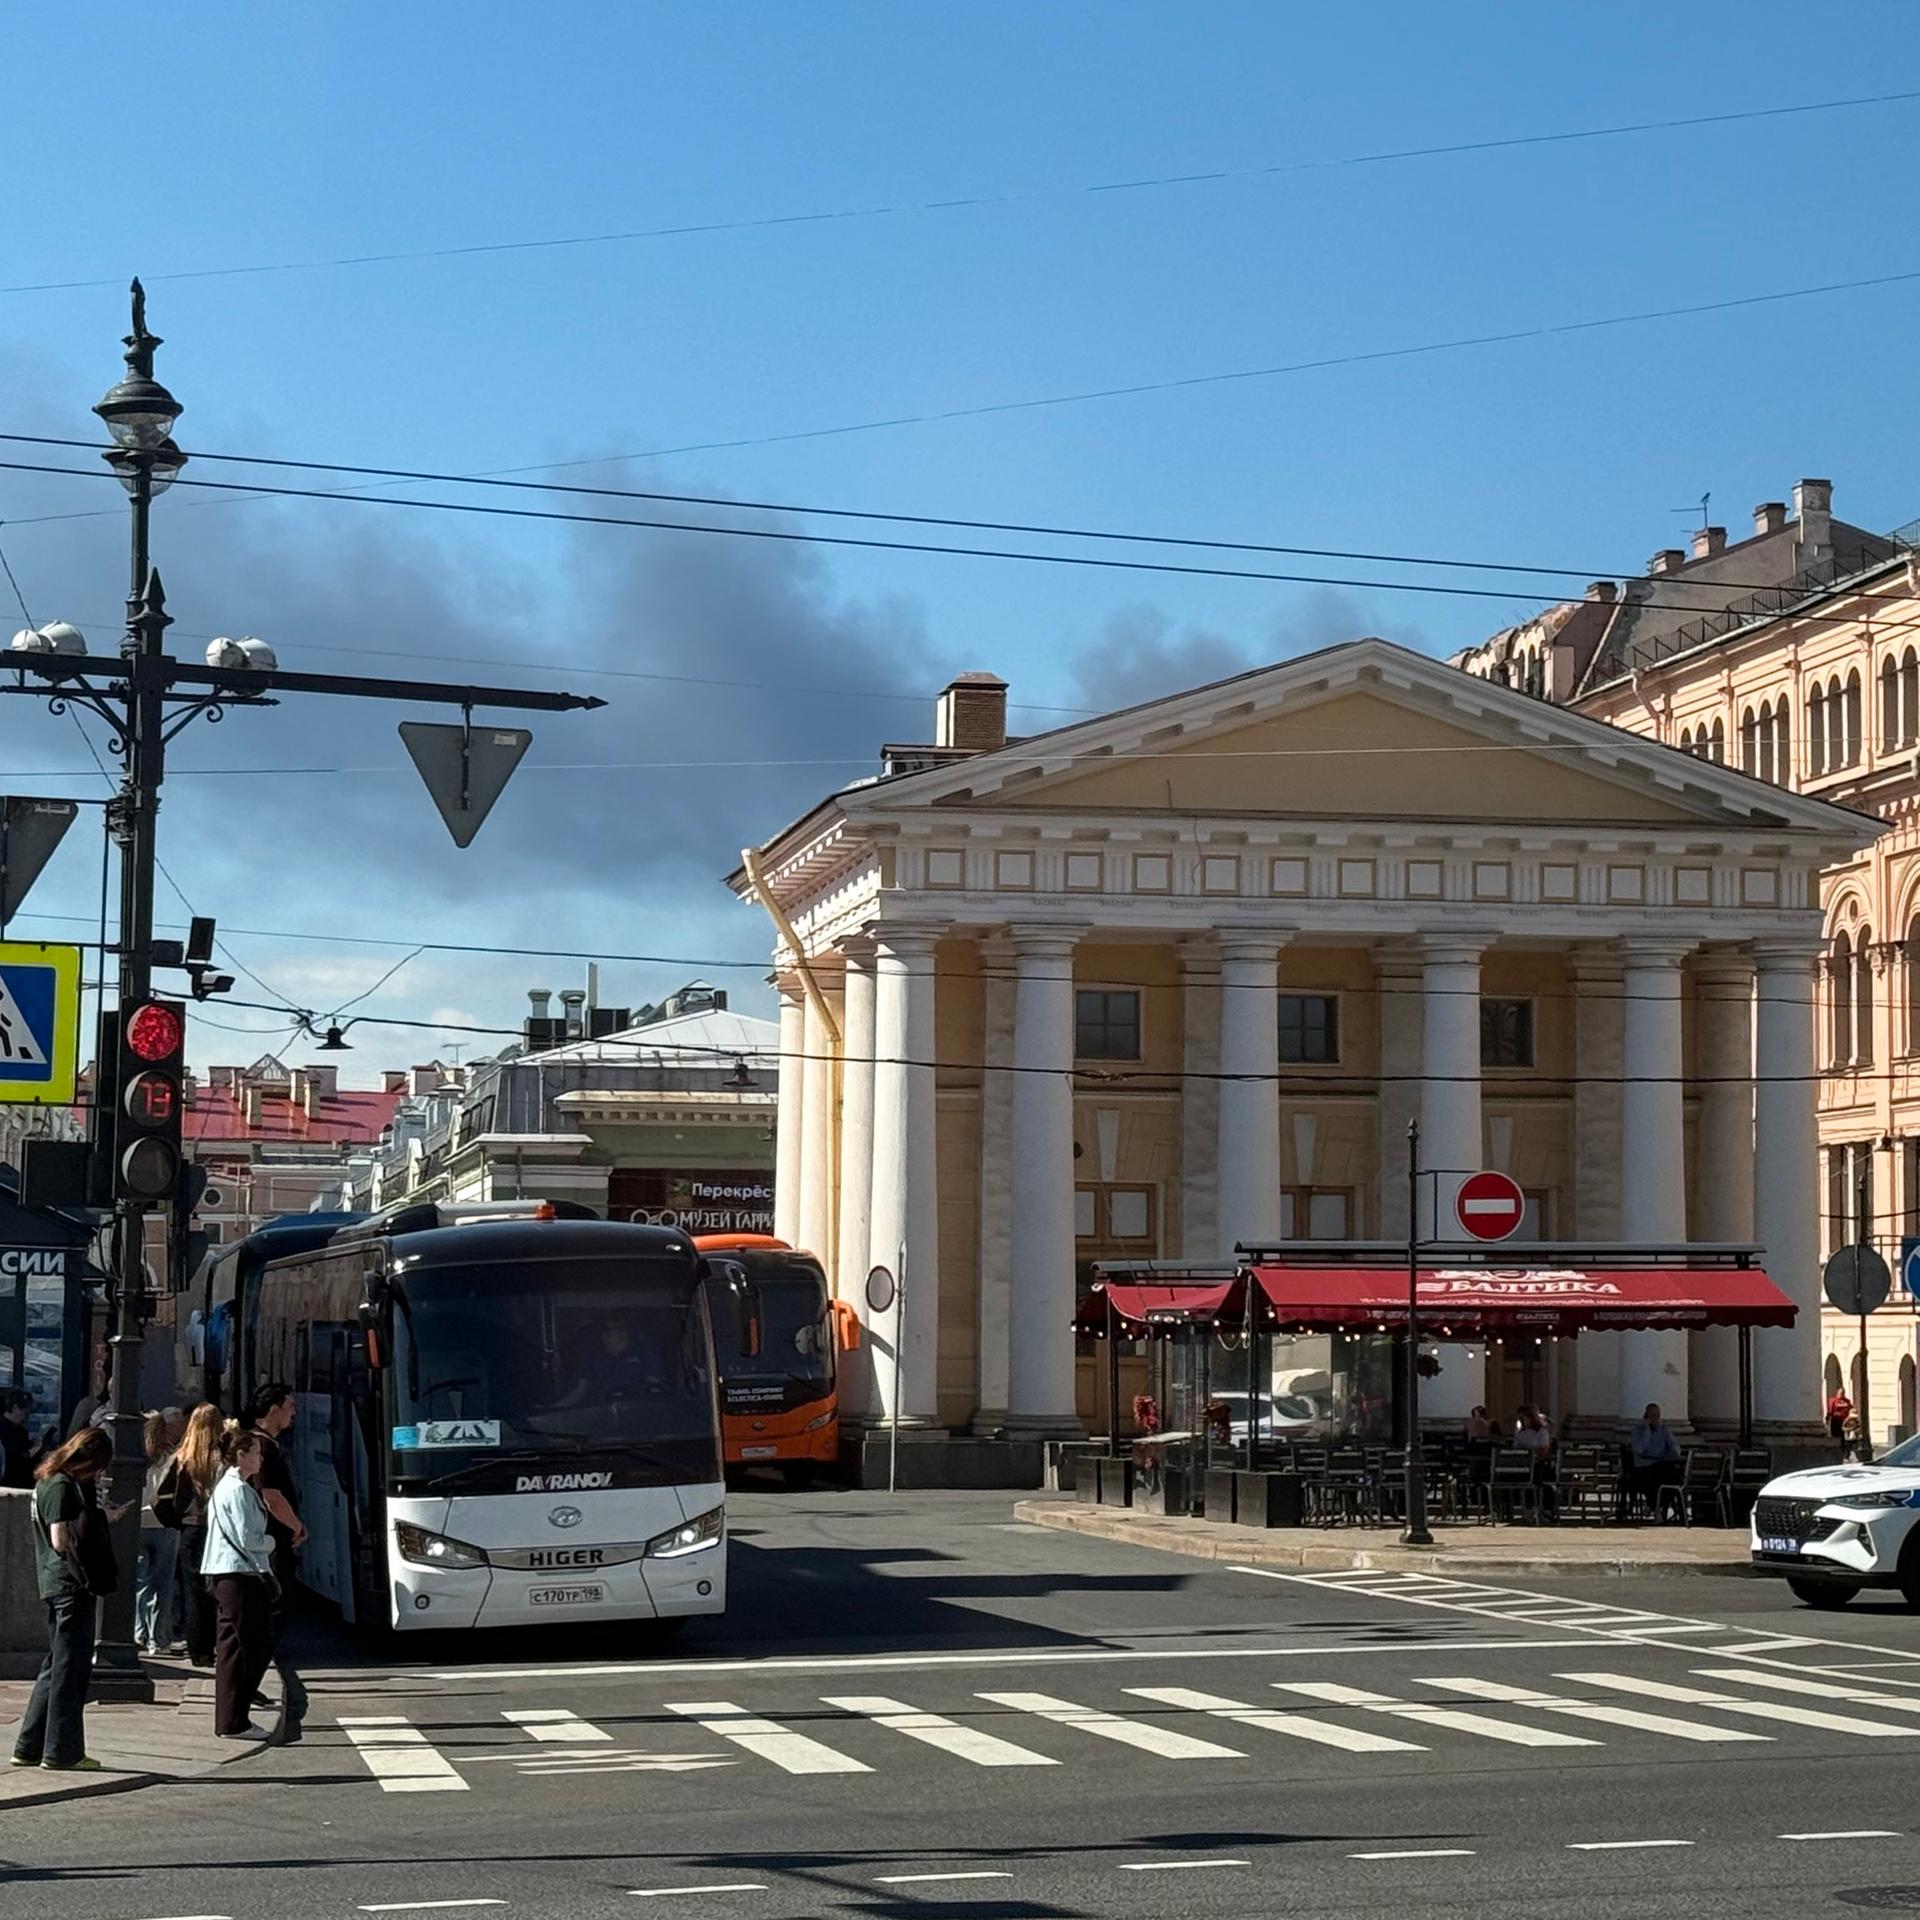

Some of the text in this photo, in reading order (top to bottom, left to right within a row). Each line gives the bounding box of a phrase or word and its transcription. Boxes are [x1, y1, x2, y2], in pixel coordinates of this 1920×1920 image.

[692, 1183, 773, 1200] Перекрёс
[679, 1209, 730, 1230] МУЗЕЙ
[1, 1250, 65, 1274] СИИ
[1449, 1280, 1622, 1294] БАЛТИКА
[529, 1550, 604, 1566] HIGER
